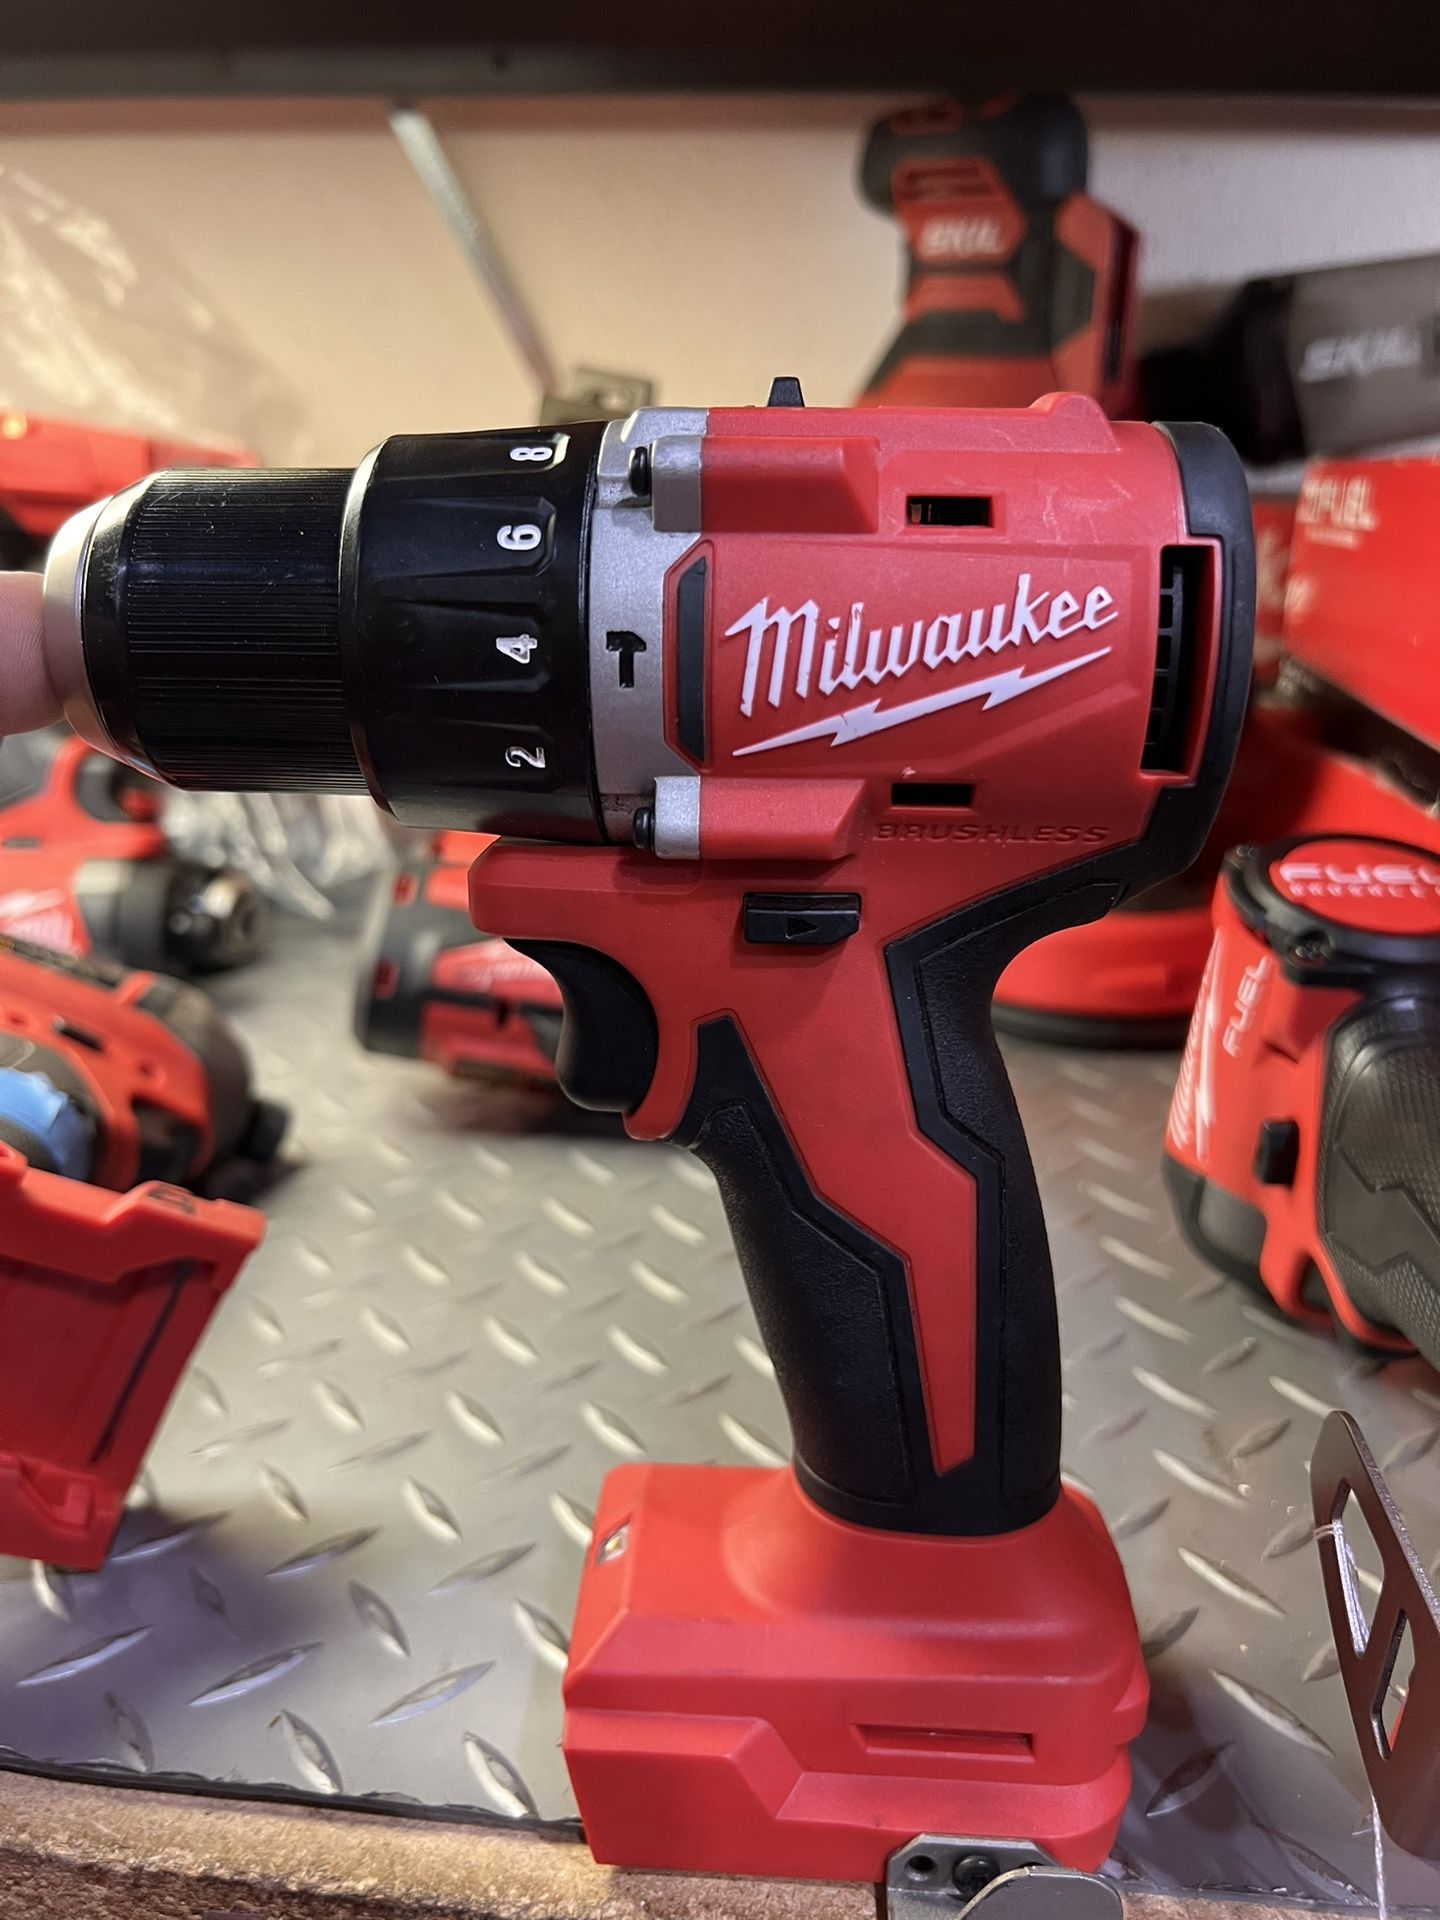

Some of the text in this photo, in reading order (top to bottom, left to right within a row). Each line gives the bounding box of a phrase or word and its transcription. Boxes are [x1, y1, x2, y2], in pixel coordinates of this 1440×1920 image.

[509, 446, 553, 462] 8
[496, 524, 542, 551] 6
[496, 634, 538, 664] 4
[724, 573, 1119, 719] Milwaukee
[505, 746, 546, 769] 2
[873, 822, 1110, 845] BRUSHLESS
[1222, 955, 1272, 1058] FUEL
